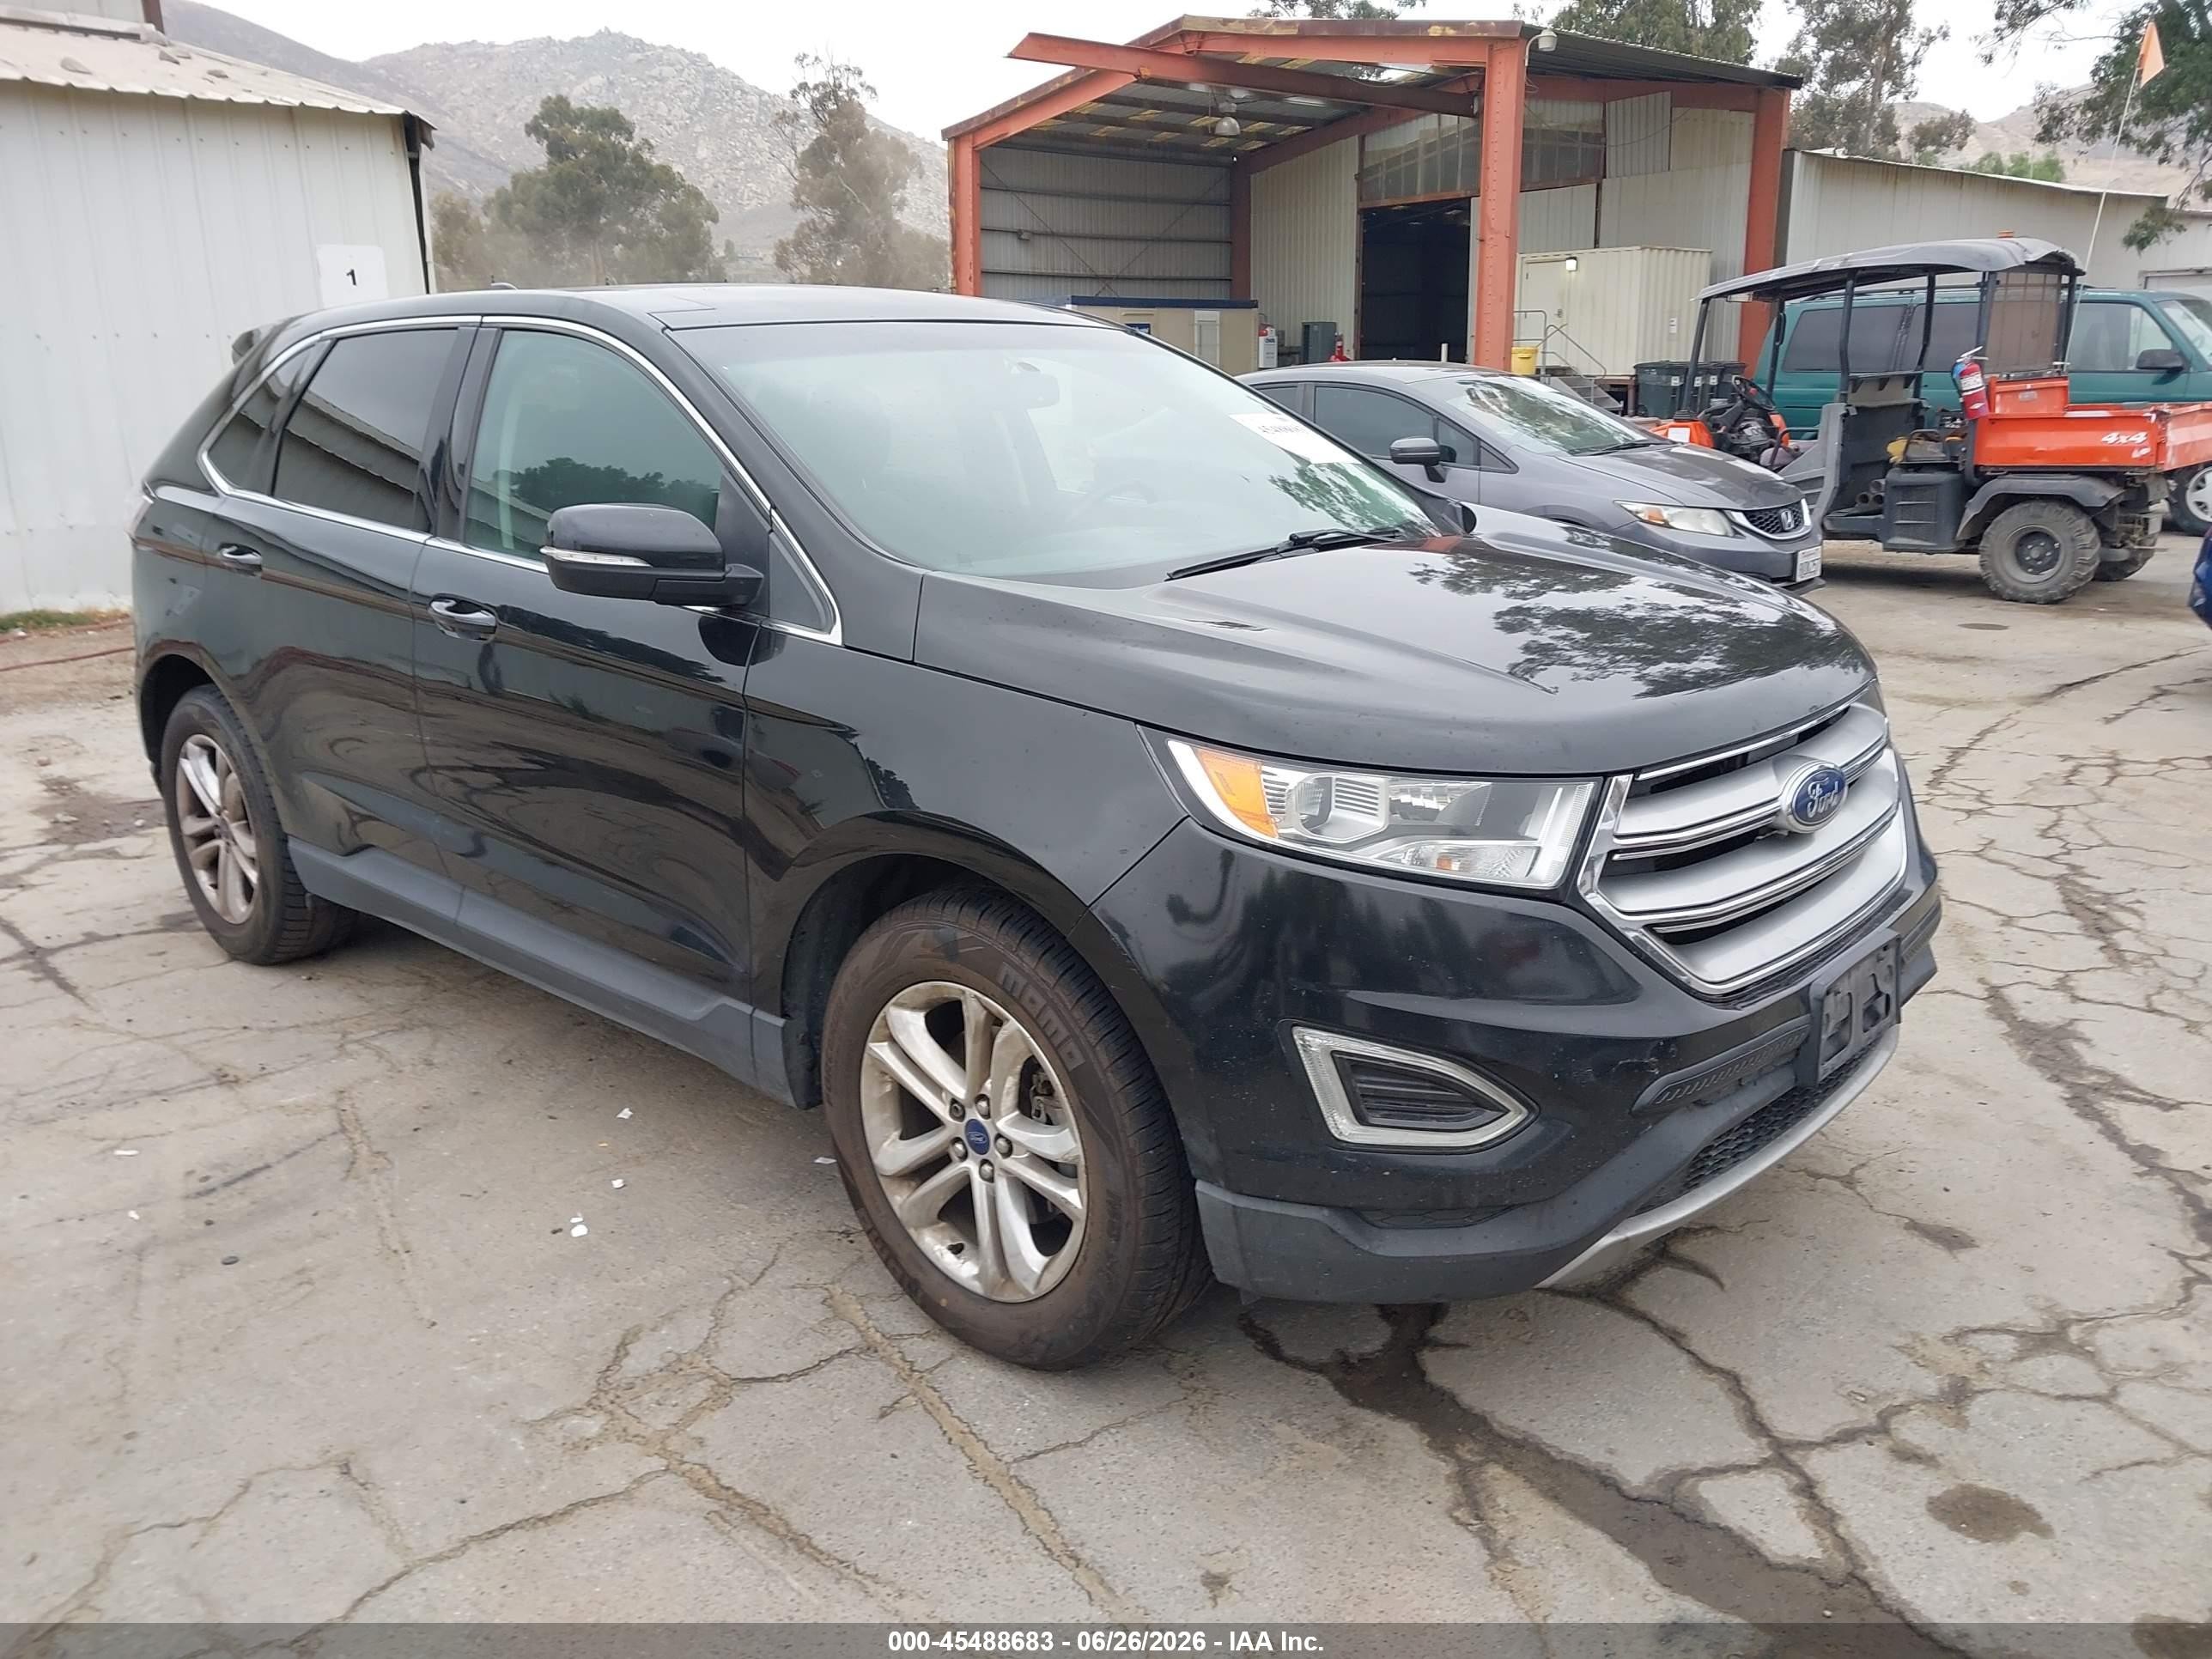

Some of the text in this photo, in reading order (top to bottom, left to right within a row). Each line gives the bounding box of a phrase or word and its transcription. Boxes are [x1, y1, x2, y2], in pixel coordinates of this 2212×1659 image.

[346, 269, 356, 286] 1
[2100, 431, 2148, 445] 4x4
[1807, 776, 1839, 818] Ford
